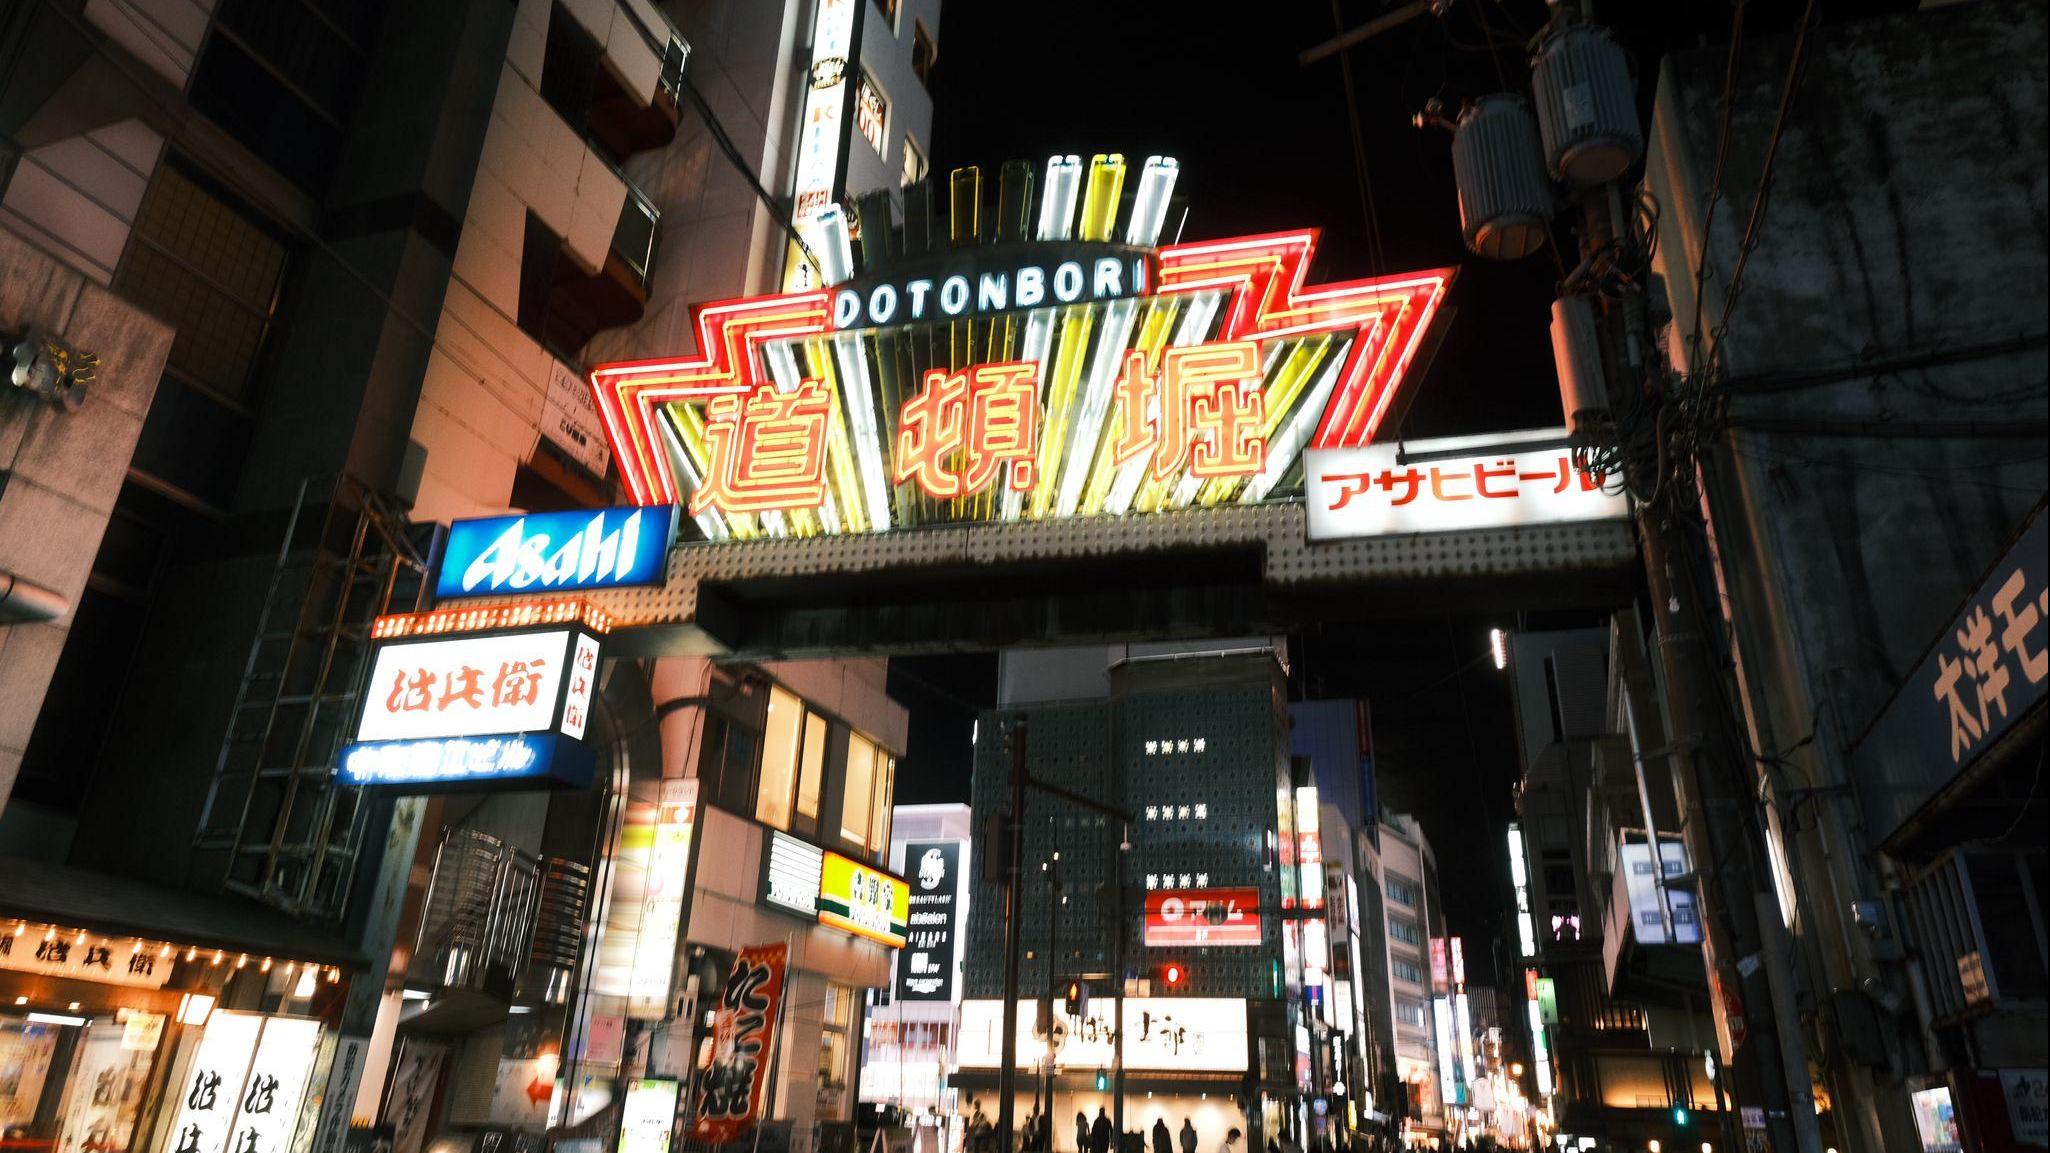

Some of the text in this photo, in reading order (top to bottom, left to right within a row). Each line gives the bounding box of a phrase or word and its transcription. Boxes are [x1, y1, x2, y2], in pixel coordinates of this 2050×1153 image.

[834, 258, 1144, 329] DOTONBORI
[690, 341, 1267, 515] 道頓堀
[1321, 458, 1606, 511] アサヒビール
[462, 508, 642, 592] Asahi
[386, 659, 546, 714] 治兵衛
[566, 646, 594, 729] 治兵衛
